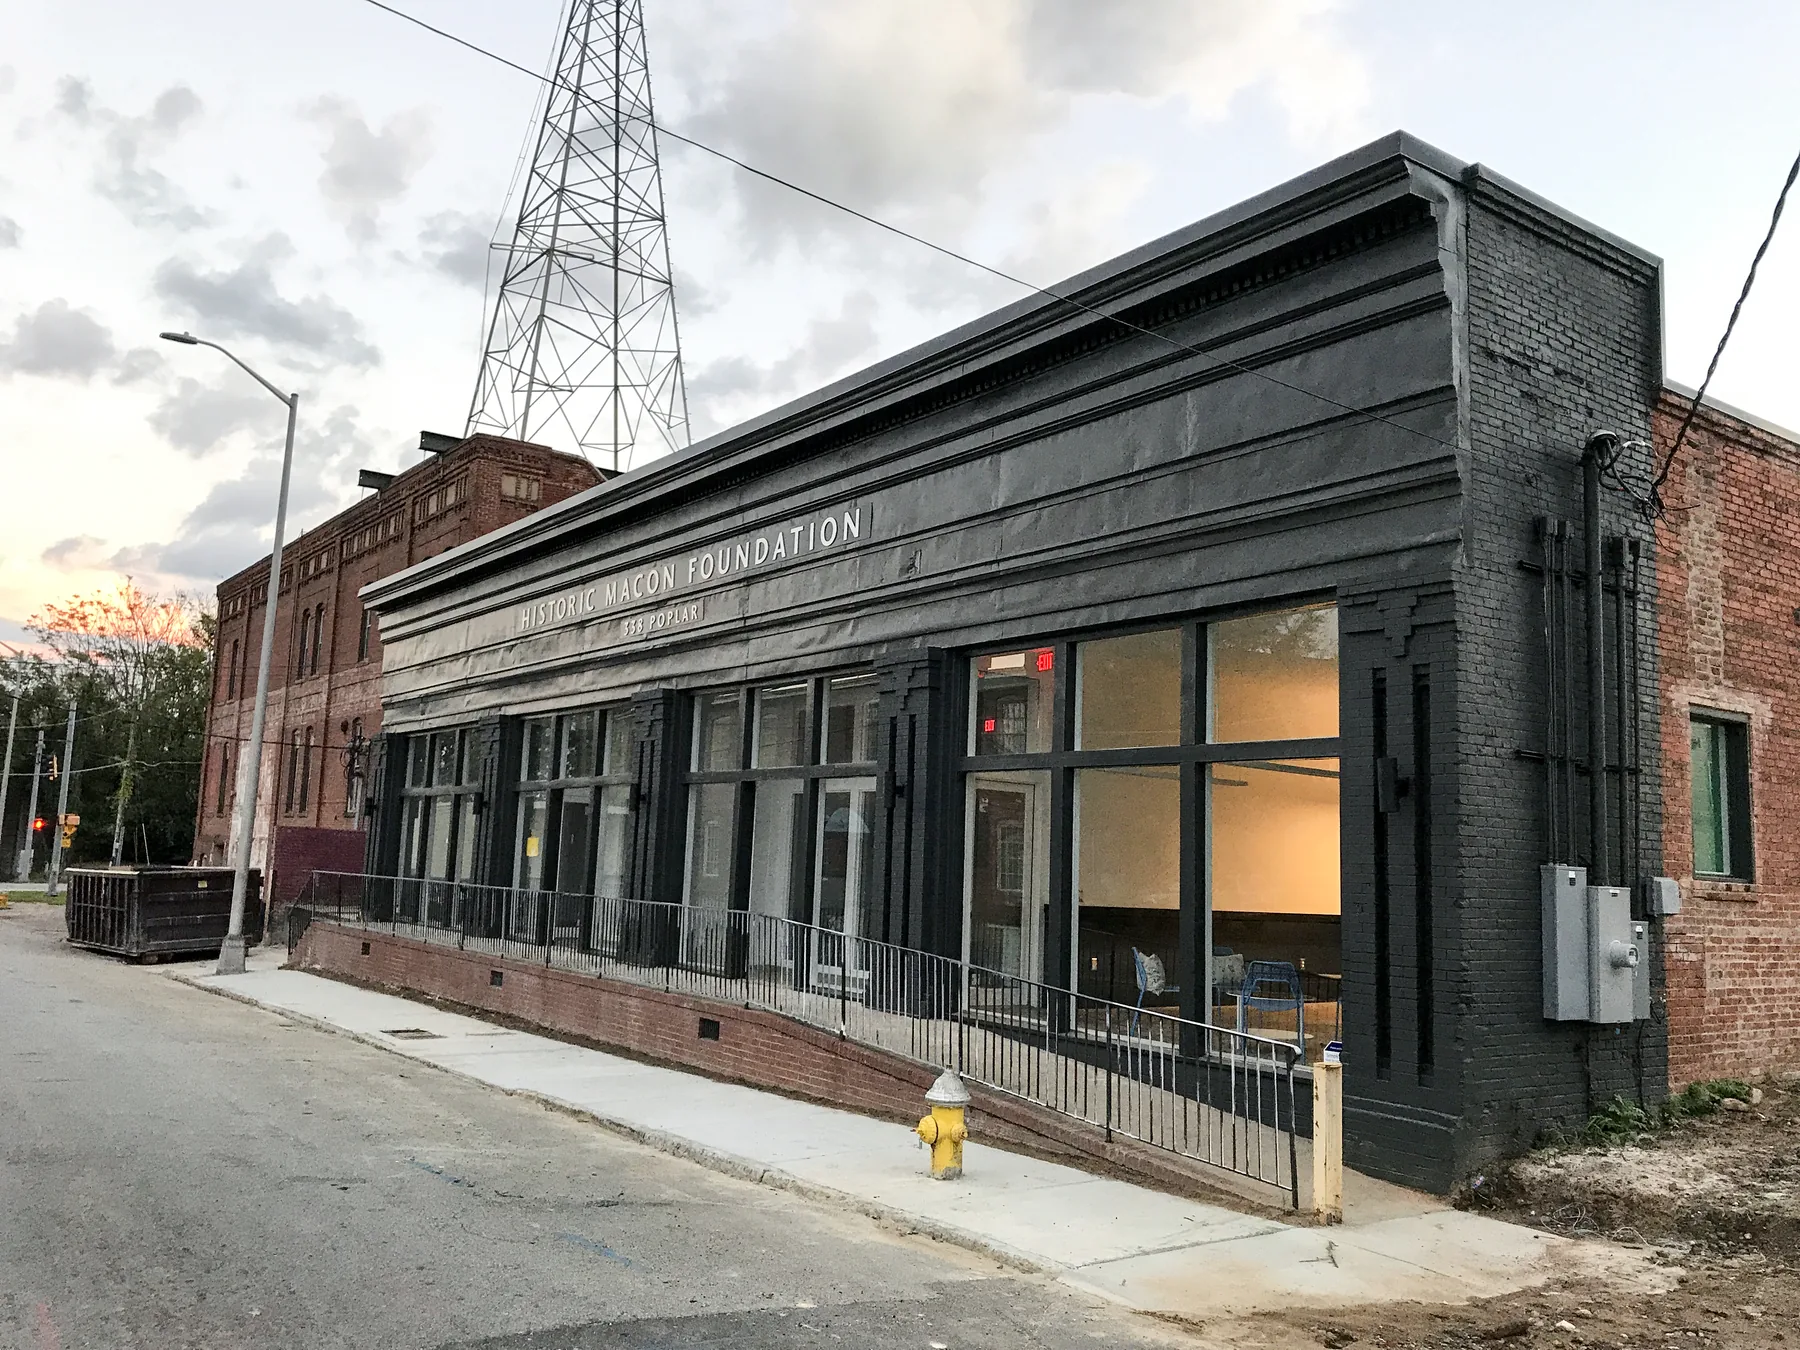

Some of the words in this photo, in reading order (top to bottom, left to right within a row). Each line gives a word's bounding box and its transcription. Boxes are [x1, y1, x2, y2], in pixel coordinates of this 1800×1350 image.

[522, 588, 596, 629] HISTORIC
[605, 562, 675, 606] MACON
[688, 507, 862, 583] FOUNDATION
[649, 605, 698, 629] POPLAR
[1039, 653, 1054, 671] EXIT
